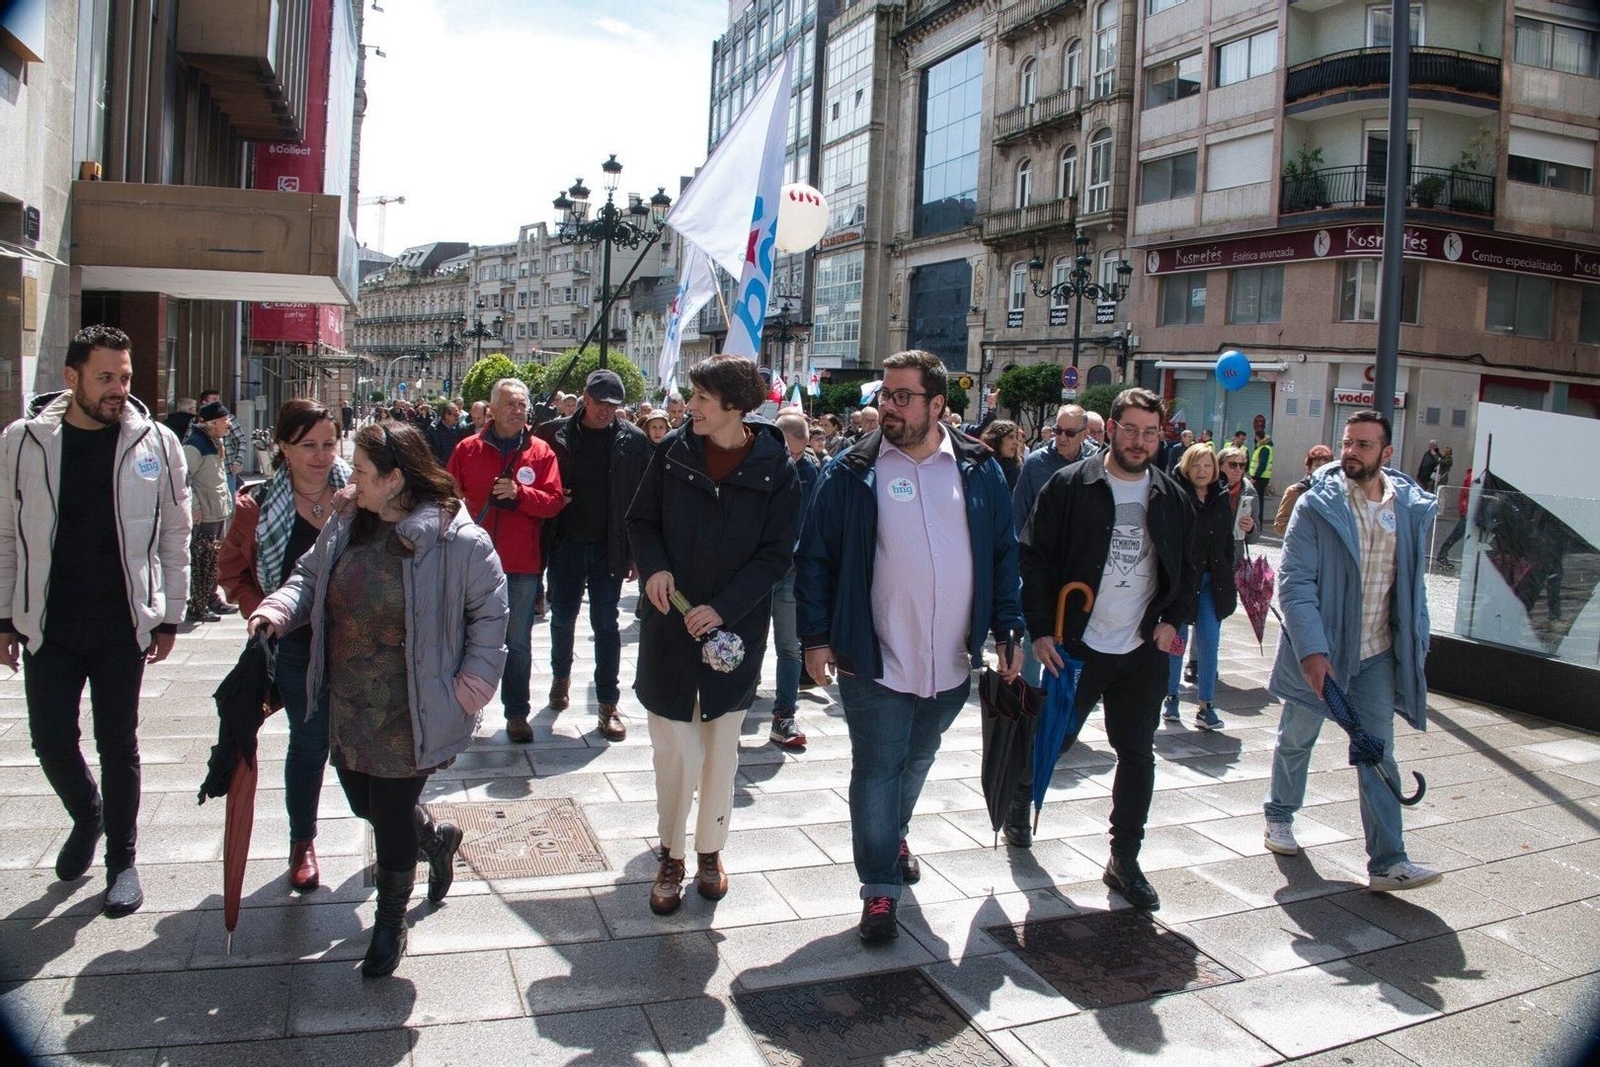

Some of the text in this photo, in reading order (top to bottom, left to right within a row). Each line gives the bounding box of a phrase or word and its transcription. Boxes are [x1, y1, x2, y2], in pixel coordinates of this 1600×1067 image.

[269, 145, 311, 155] &Collect
[1346, 226, 1428, 251] Kostés
[1175, 246, 1222, 265] Kosmetés
[1232, 246, 1295, 262] Estética avanzada
[1471, 249, 1563, 273] Centro especializado
[1338, 392, 1401, 406] vodae
[139, 461, 159, 473] bng
[892, 485, 913, 495] bng
